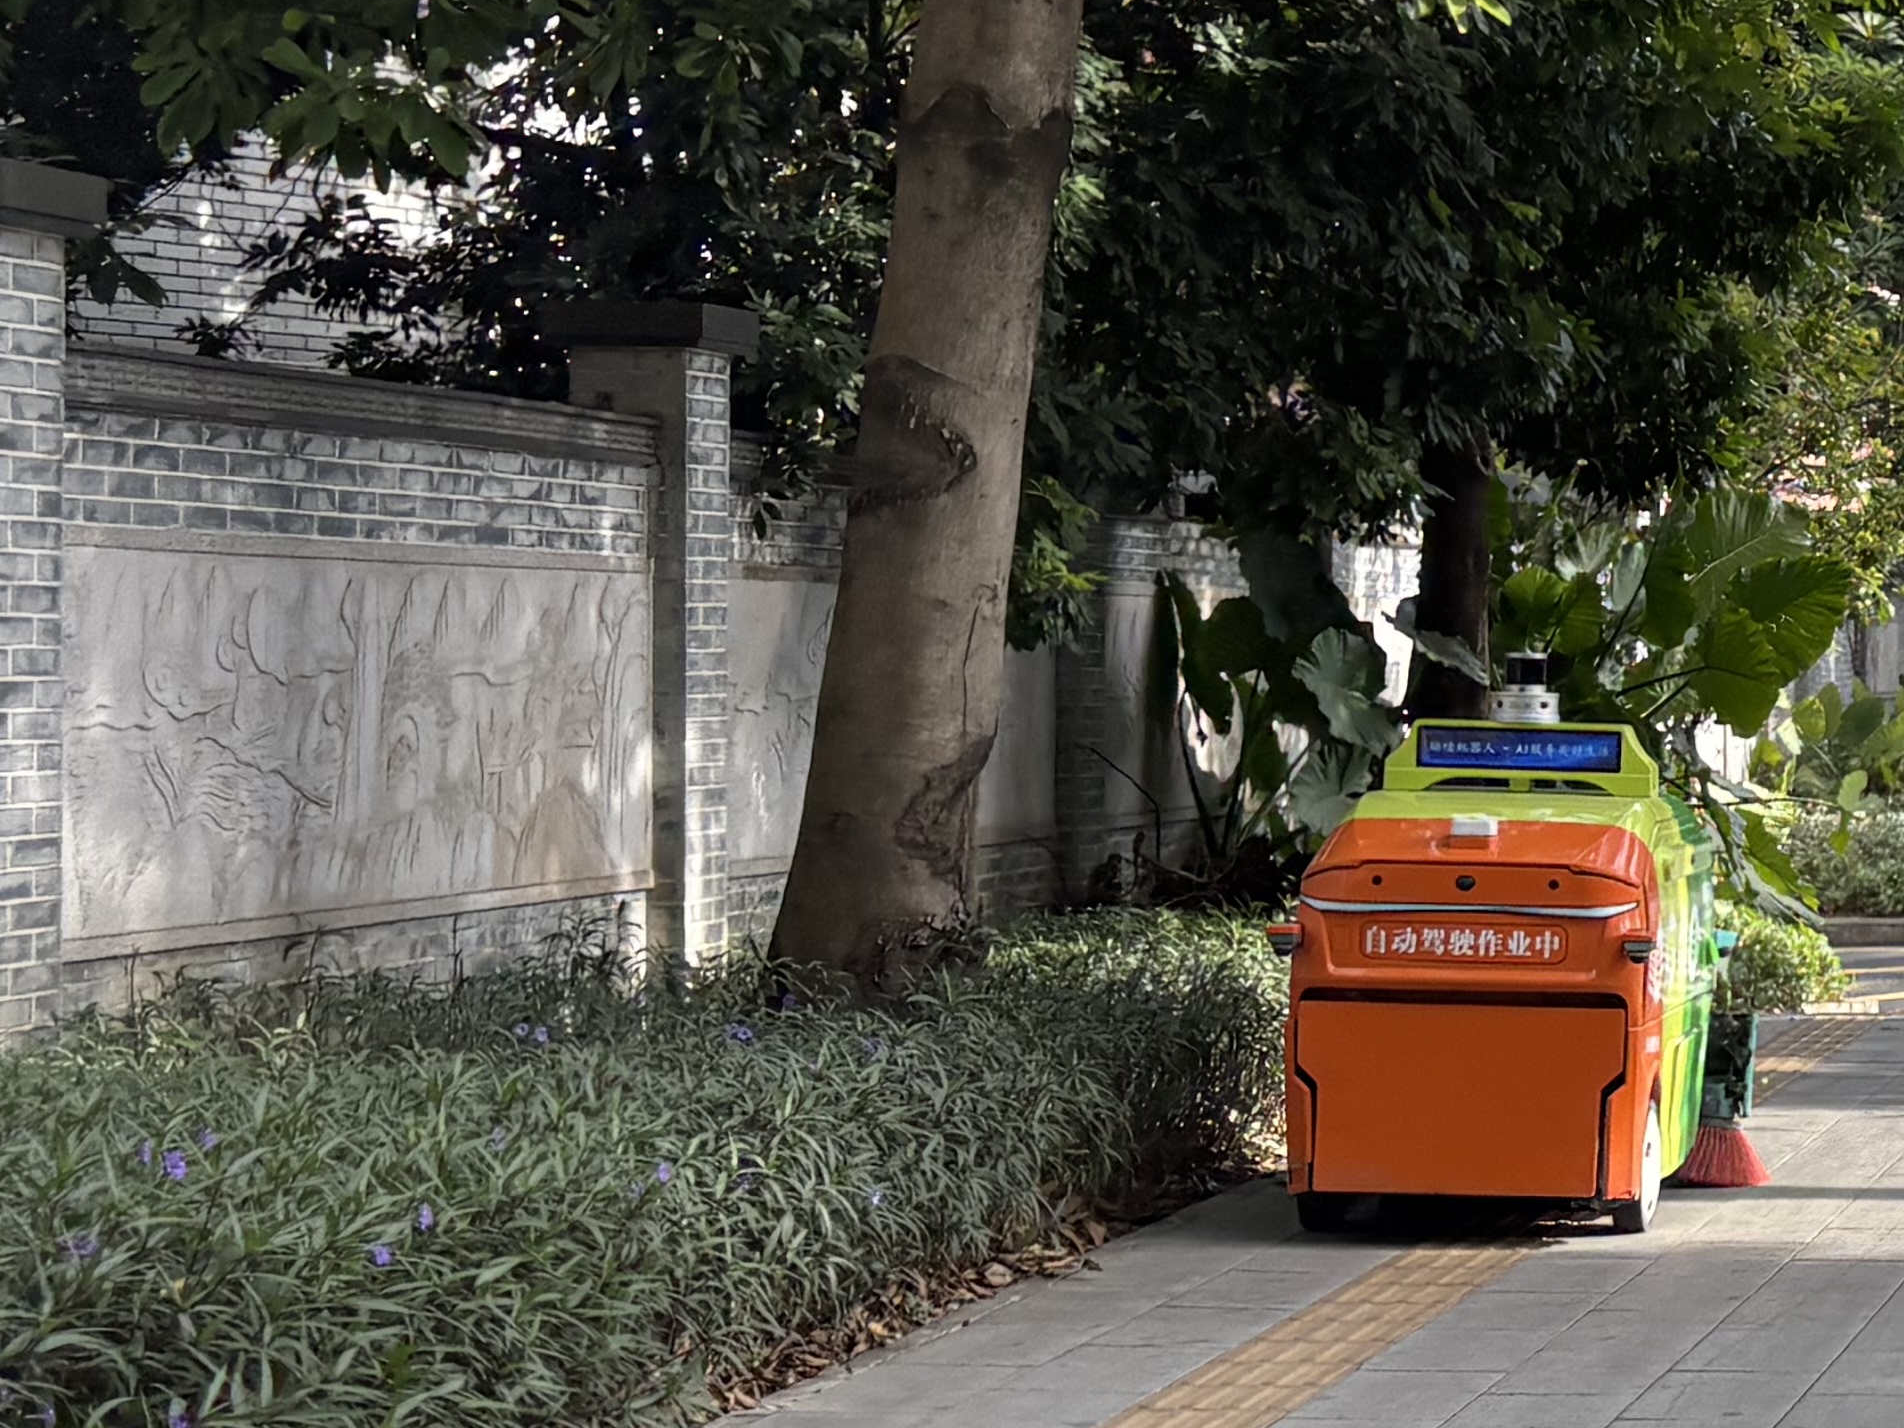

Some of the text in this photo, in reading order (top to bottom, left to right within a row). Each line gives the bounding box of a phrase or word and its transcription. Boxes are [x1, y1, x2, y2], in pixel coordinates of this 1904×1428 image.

[1365, 925, 1561, 959] 自动驾驶作业中
